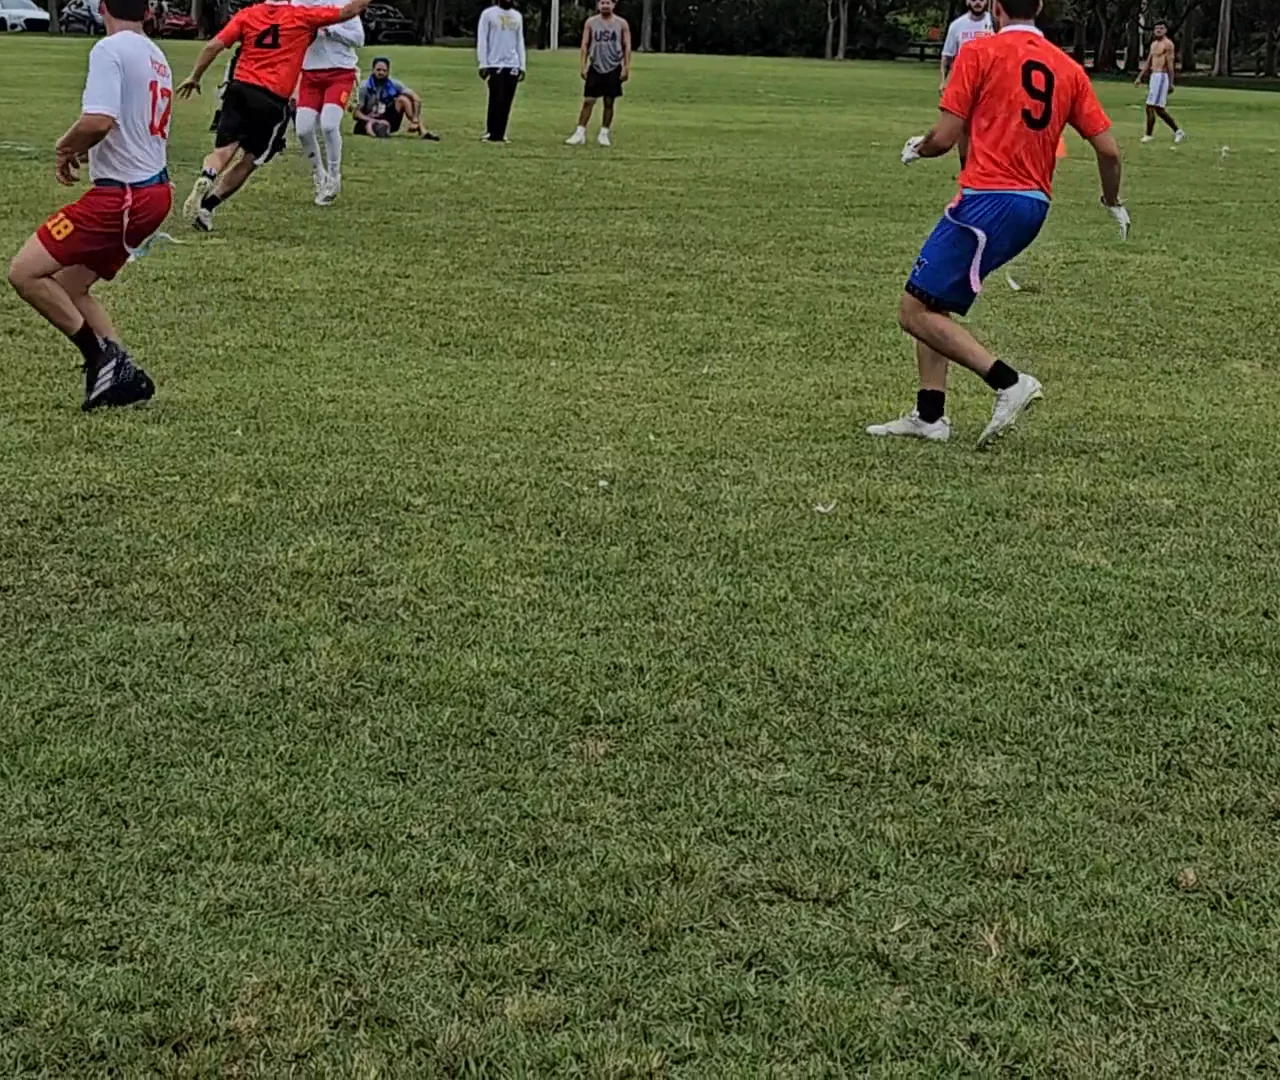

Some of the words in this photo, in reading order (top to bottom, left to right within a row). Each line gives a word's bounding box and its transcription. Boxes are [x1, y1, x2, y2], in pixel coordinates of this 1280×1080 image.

[254, 23, 282, 49] 4
[594, 29, 618, 42] USA
[1021, 59, 1055, 131] 9
